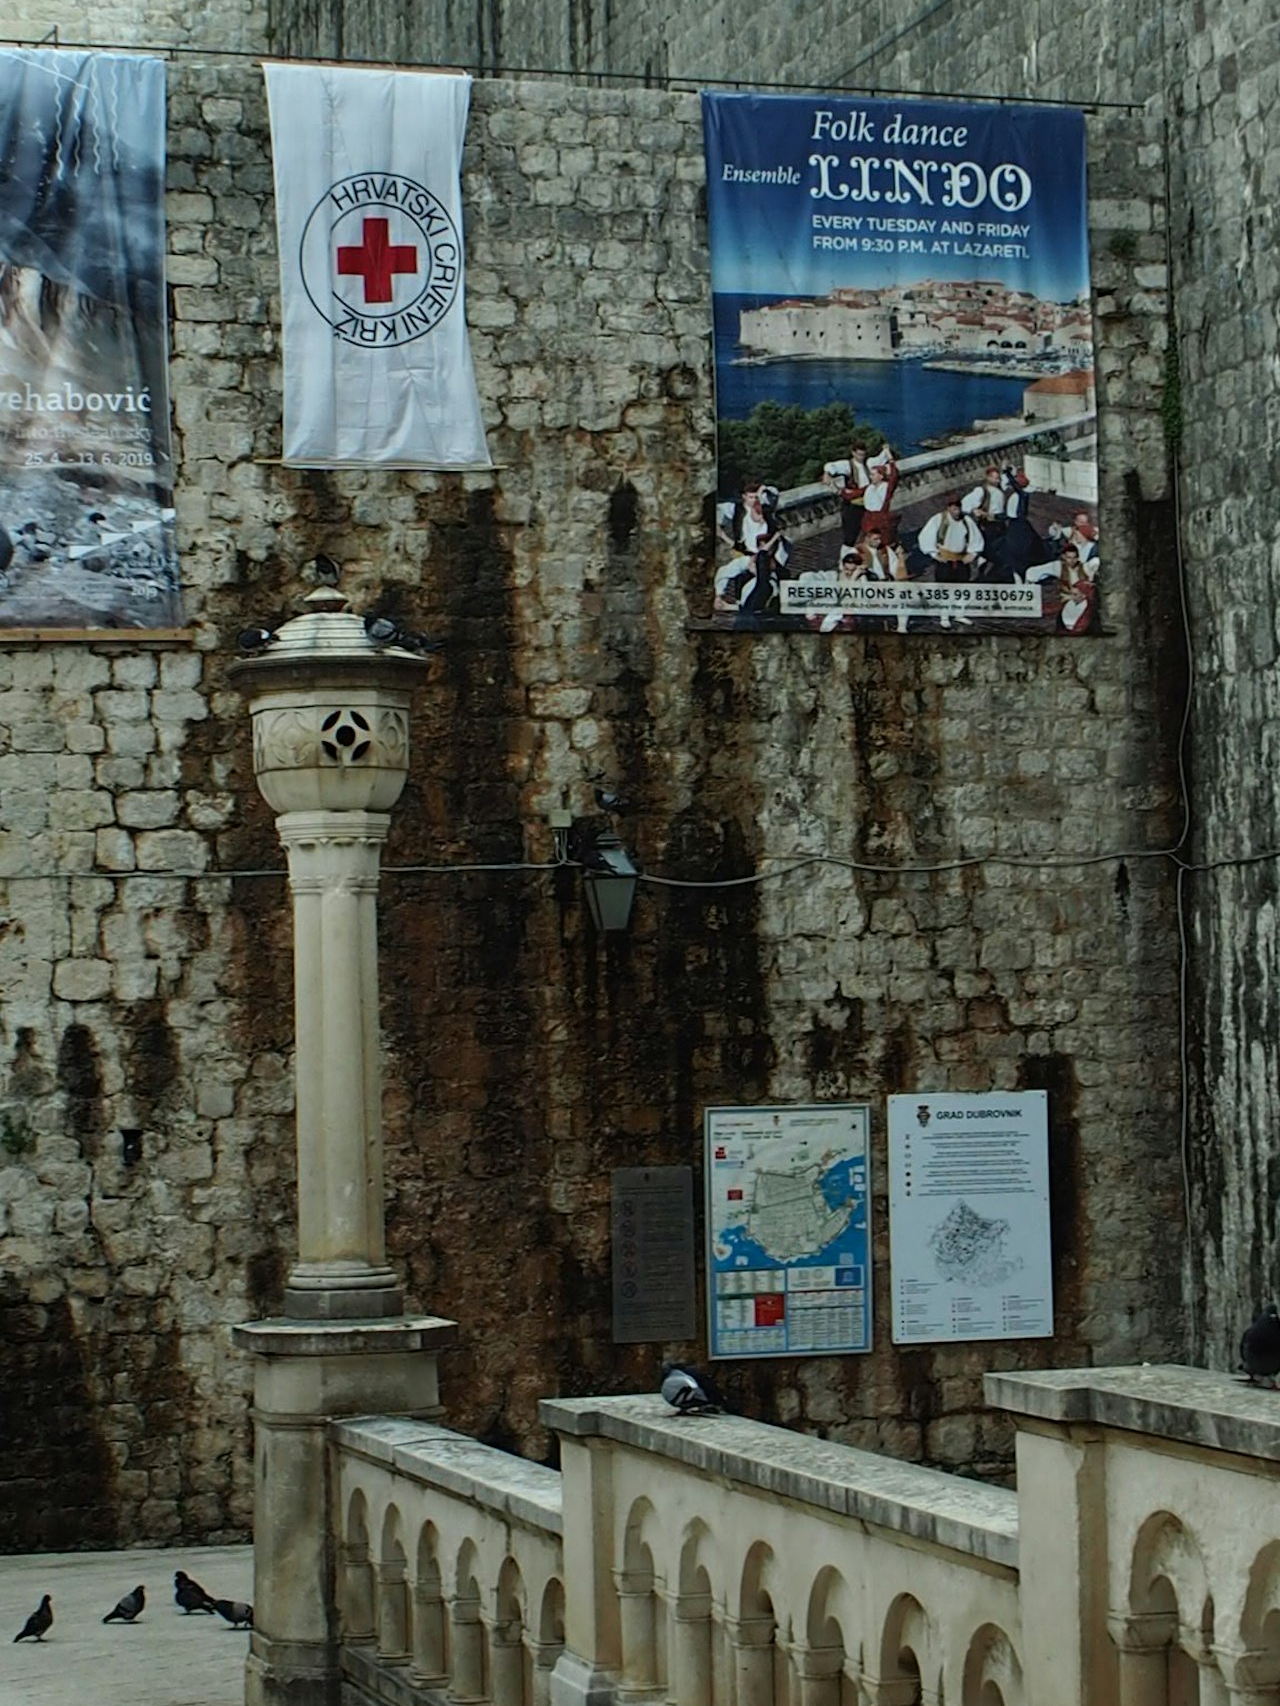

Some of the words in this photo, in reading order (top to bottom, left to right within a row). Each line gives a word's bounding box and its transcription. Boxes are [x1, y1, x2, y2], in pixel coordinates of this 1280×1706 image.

[811, 110, 875, 142] Folk
[883, 113, 968, 147] dance
[722, 163, 801, 185] Ensemble
[812, 214, 863, 230] EVERY
[867, 217, 936, 233] TUESDAY
[940, 221, 973, 235] AND
[977, 223, 1031, 238] FRIDAY
[330, 177, 449, 237] HRVATSKI
[401, 243, 457, 335] CRVENI
[813, 236, 857, 251] FROM
[861, 238, 894, 253] 9:30
[898, 239, 927, 254] P.M.
[931, 241, 950, 255] AT
[787, 586, 895, 599] RESERVATIONS
[900, 588, 913, 600] at
[916, 589, 950, 601] +385
[954, 589, 971, 601] 99
[975, 589, 1034, 602] 8330679
[936, 1110, 964, 1120] GRAD
[966, 1109, 1023, 1119] DUBROVNIK
